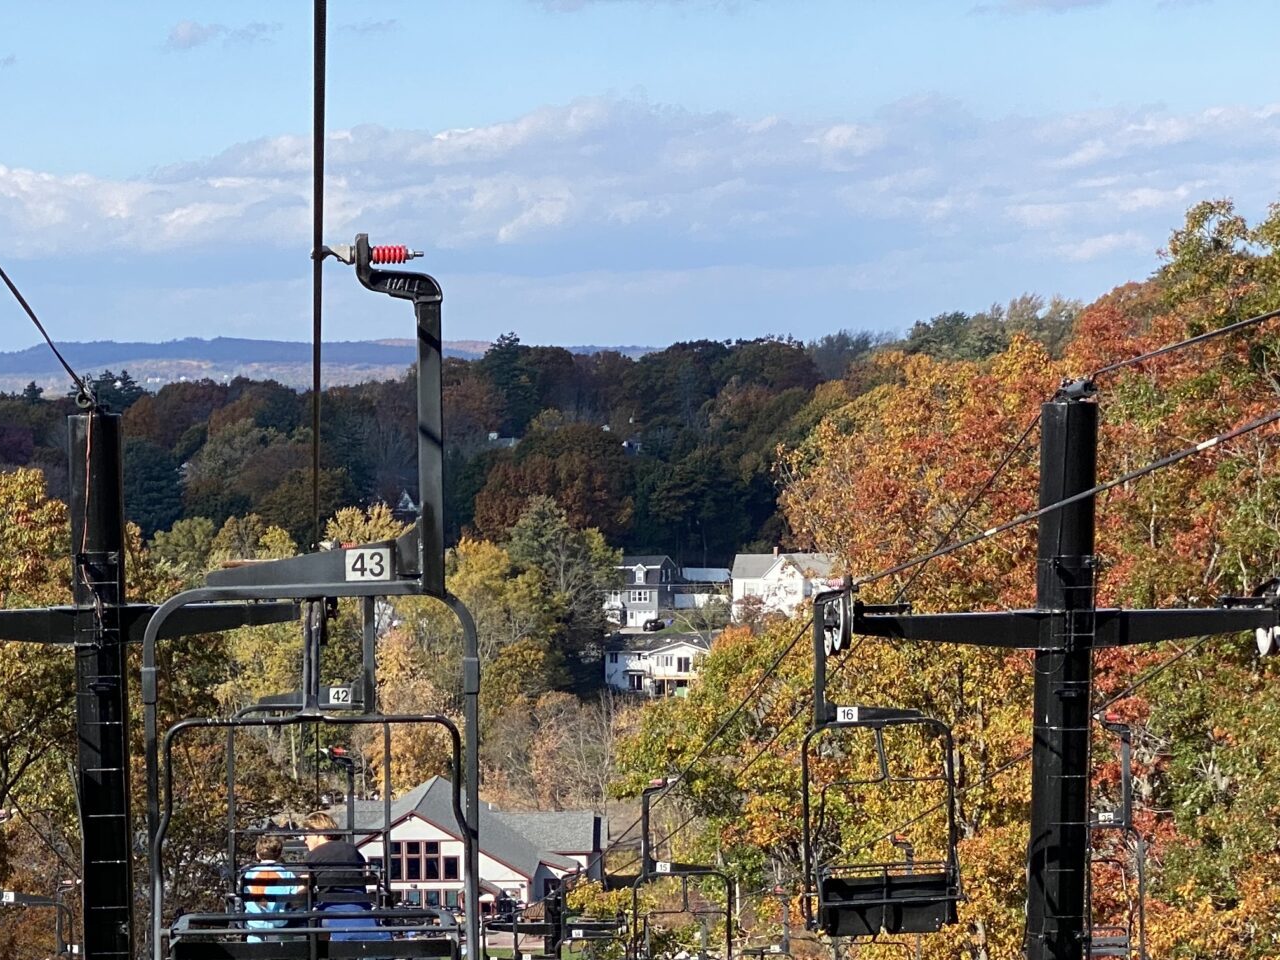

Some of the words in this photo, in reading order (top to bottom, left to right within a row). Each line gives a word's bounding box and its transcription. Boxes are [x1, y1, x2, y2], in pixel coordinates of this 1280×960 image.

[351, 551, 385, 577] 43
[332, 689, 349, 702] 42
[841, 708, 854, 720] 16
[659, 863, 668, 871] 15
